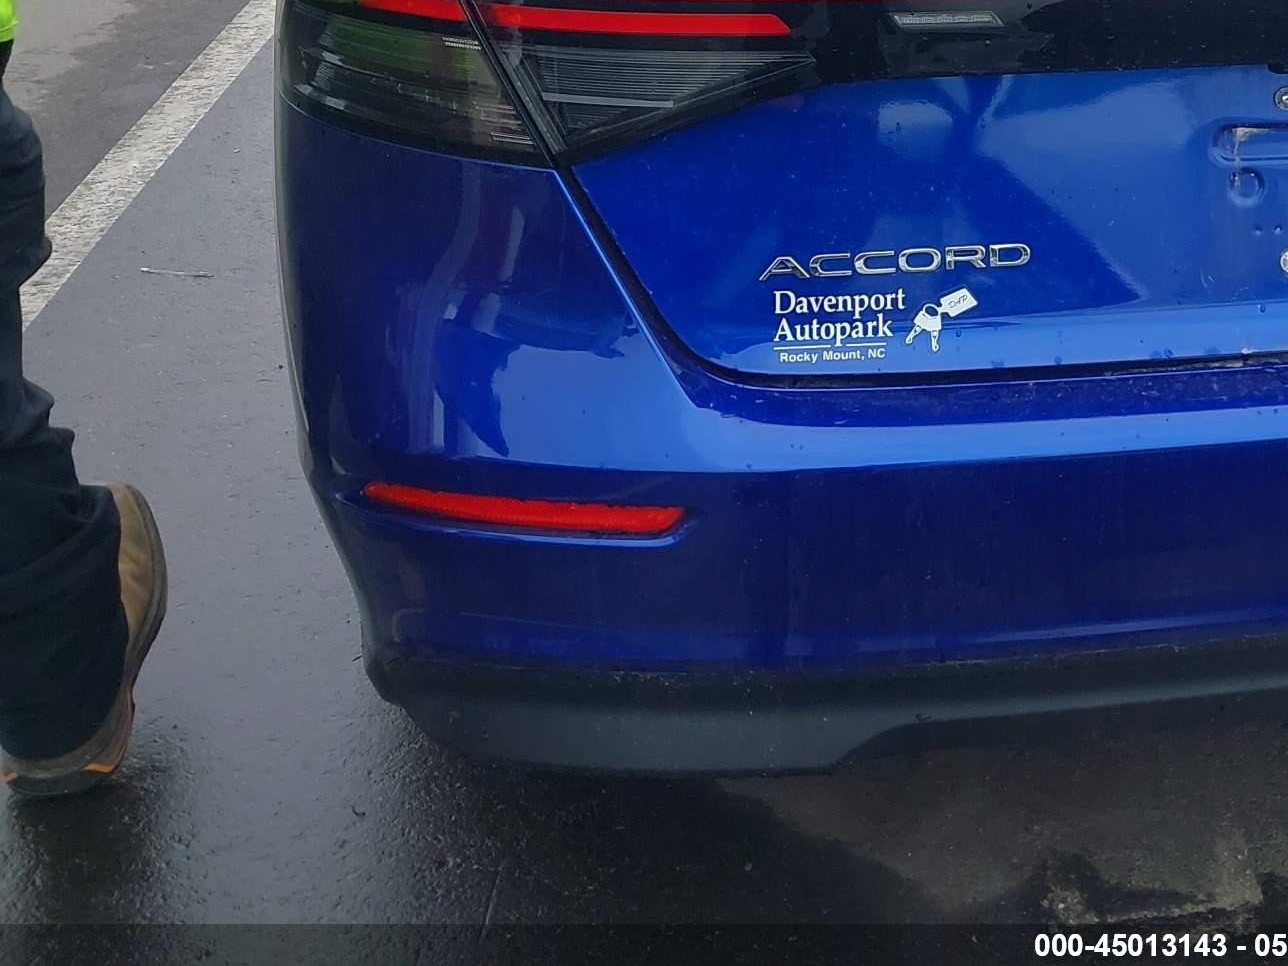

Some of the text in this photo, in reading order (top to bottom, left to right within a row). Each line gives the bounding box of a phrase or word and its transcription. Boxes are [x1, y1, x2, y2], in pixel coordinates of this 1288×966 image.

[758, 243, 1031, 281] ACCORD
[773, 288, 906, 319] Davenport
[773, 314, 893, 347] Autopark
[780, 348, 886, 364] Rocky Mount, NC
